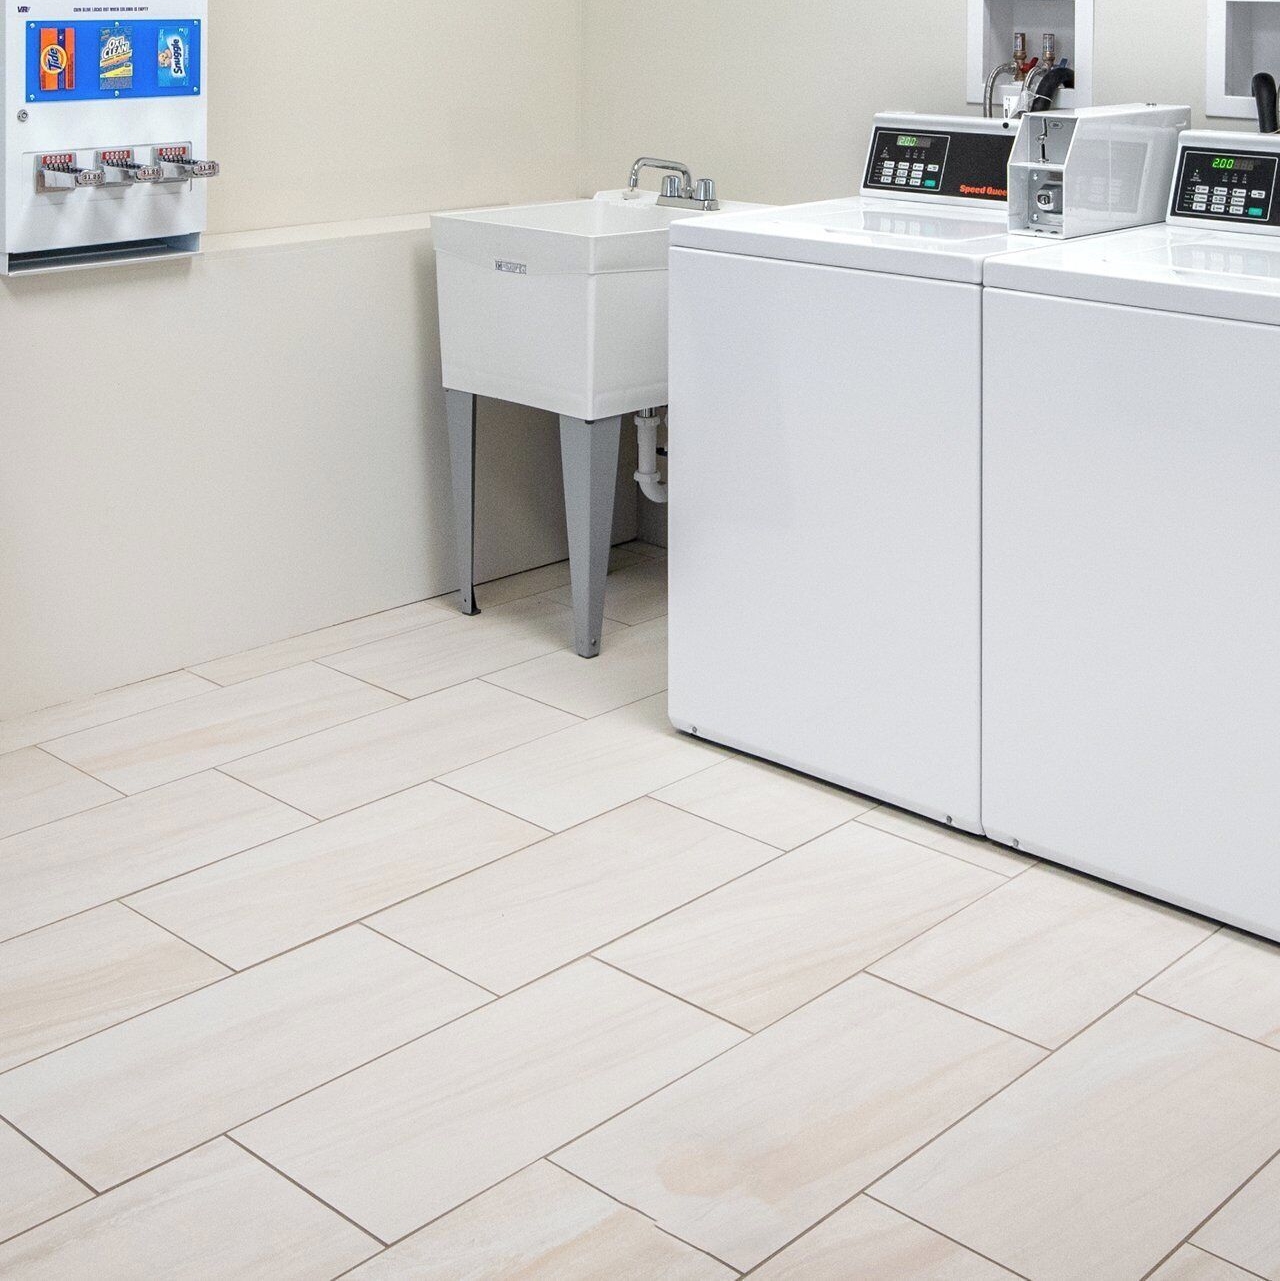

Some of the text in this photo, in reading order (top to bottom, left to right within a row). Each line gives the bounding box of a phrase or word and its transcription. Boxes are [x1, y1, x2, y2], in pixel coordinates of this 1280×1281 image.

[47, 47, 63, 71] Tide
[103, 42, 129, 59] CLEAN
[171, 38, 183, 75] Snuggle
[1212, 158, 1234, 169] 2.00
[959, 184, 985, 194] Speed
